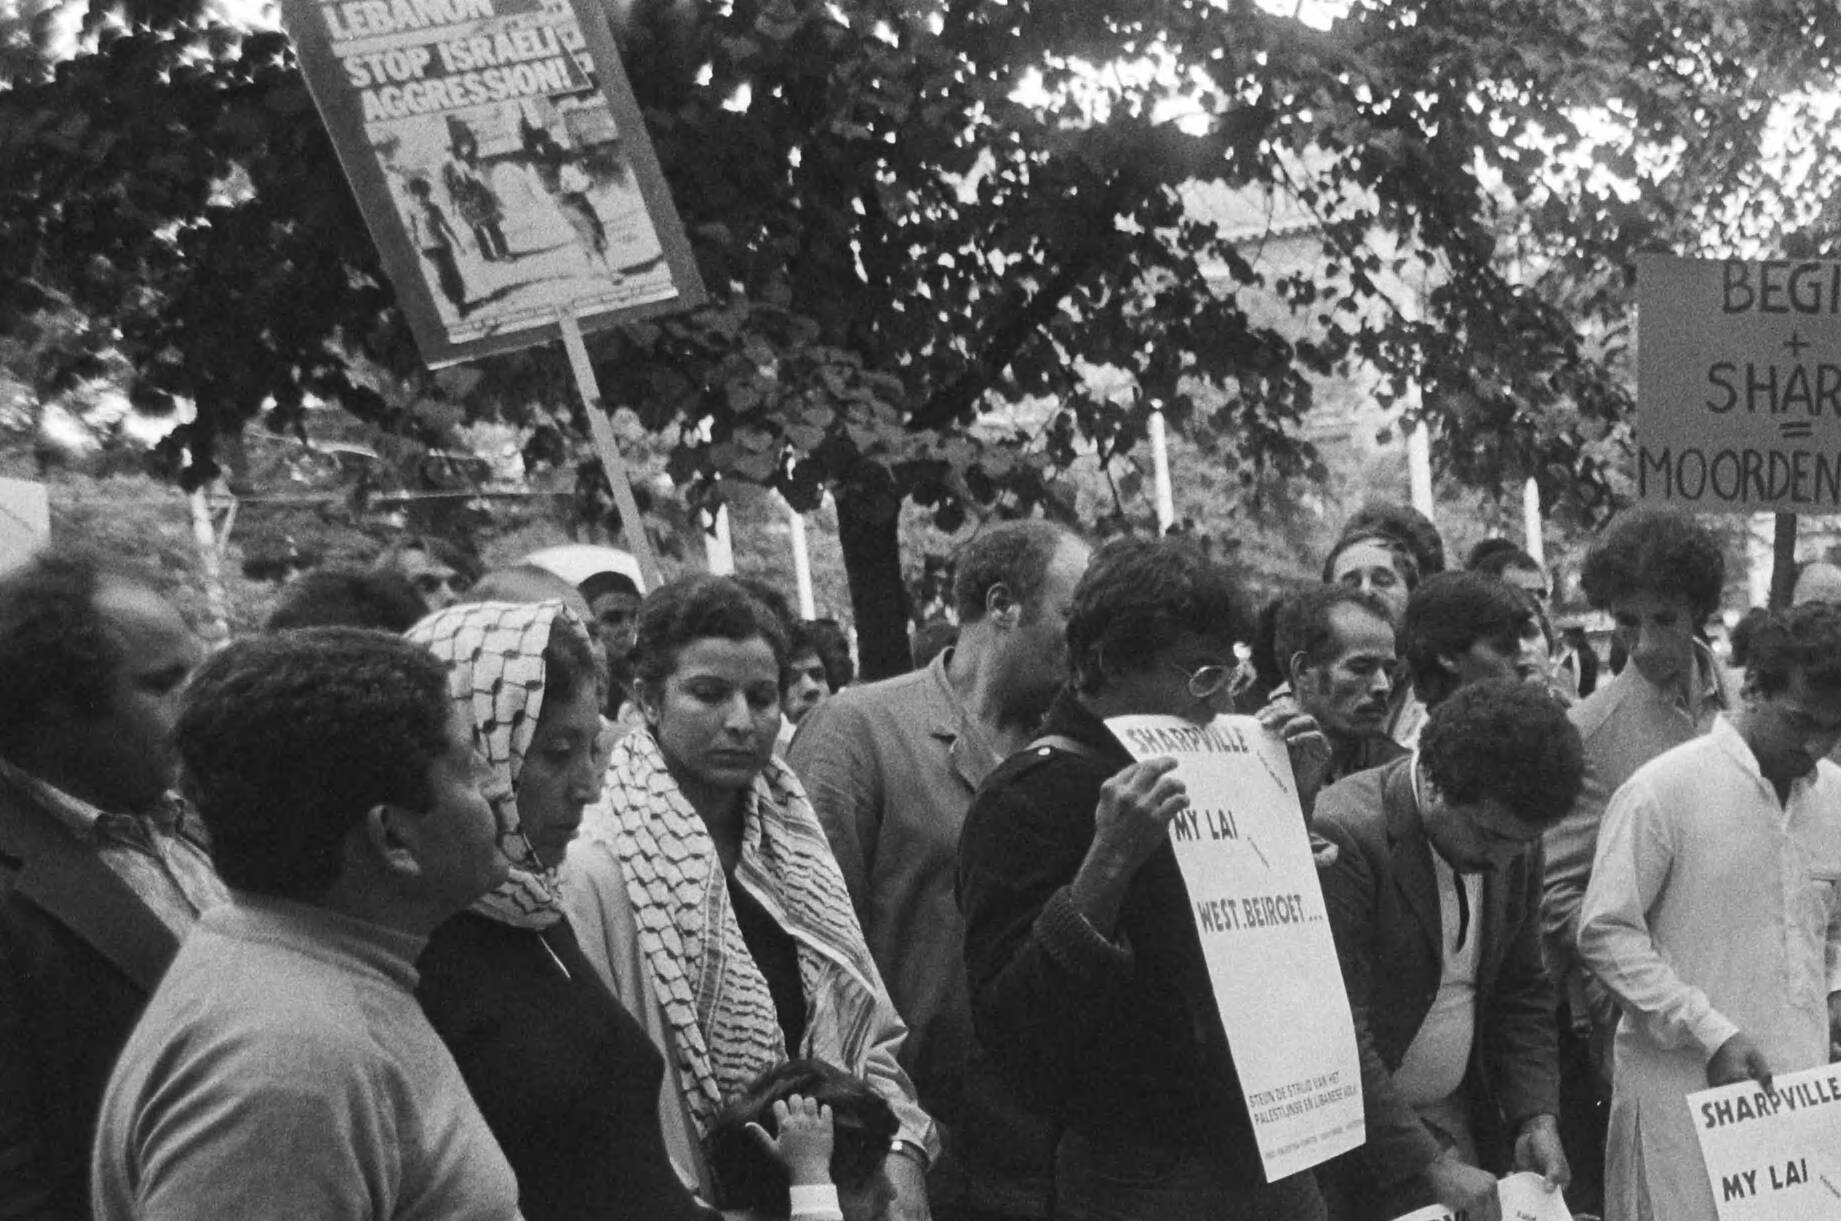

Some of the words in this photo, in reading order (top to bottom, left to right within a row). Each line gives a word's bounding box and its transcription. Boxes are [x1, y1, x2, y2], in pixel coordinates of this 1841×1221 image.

[343, 47, 431, 88] STOP
[437, 26, 562, 73] ISRAELI
[361, 56, 573, 121] AGGRESSION!
[1125, 726, 1249, 755] SHARPVILLE
[1173, 809, 1201, 842] MY
[1206, 809, 1238, 841] LAI
[1721, 1169, 1758, 1202] MY
[1769, 1158, 1809, 1191] LAI
